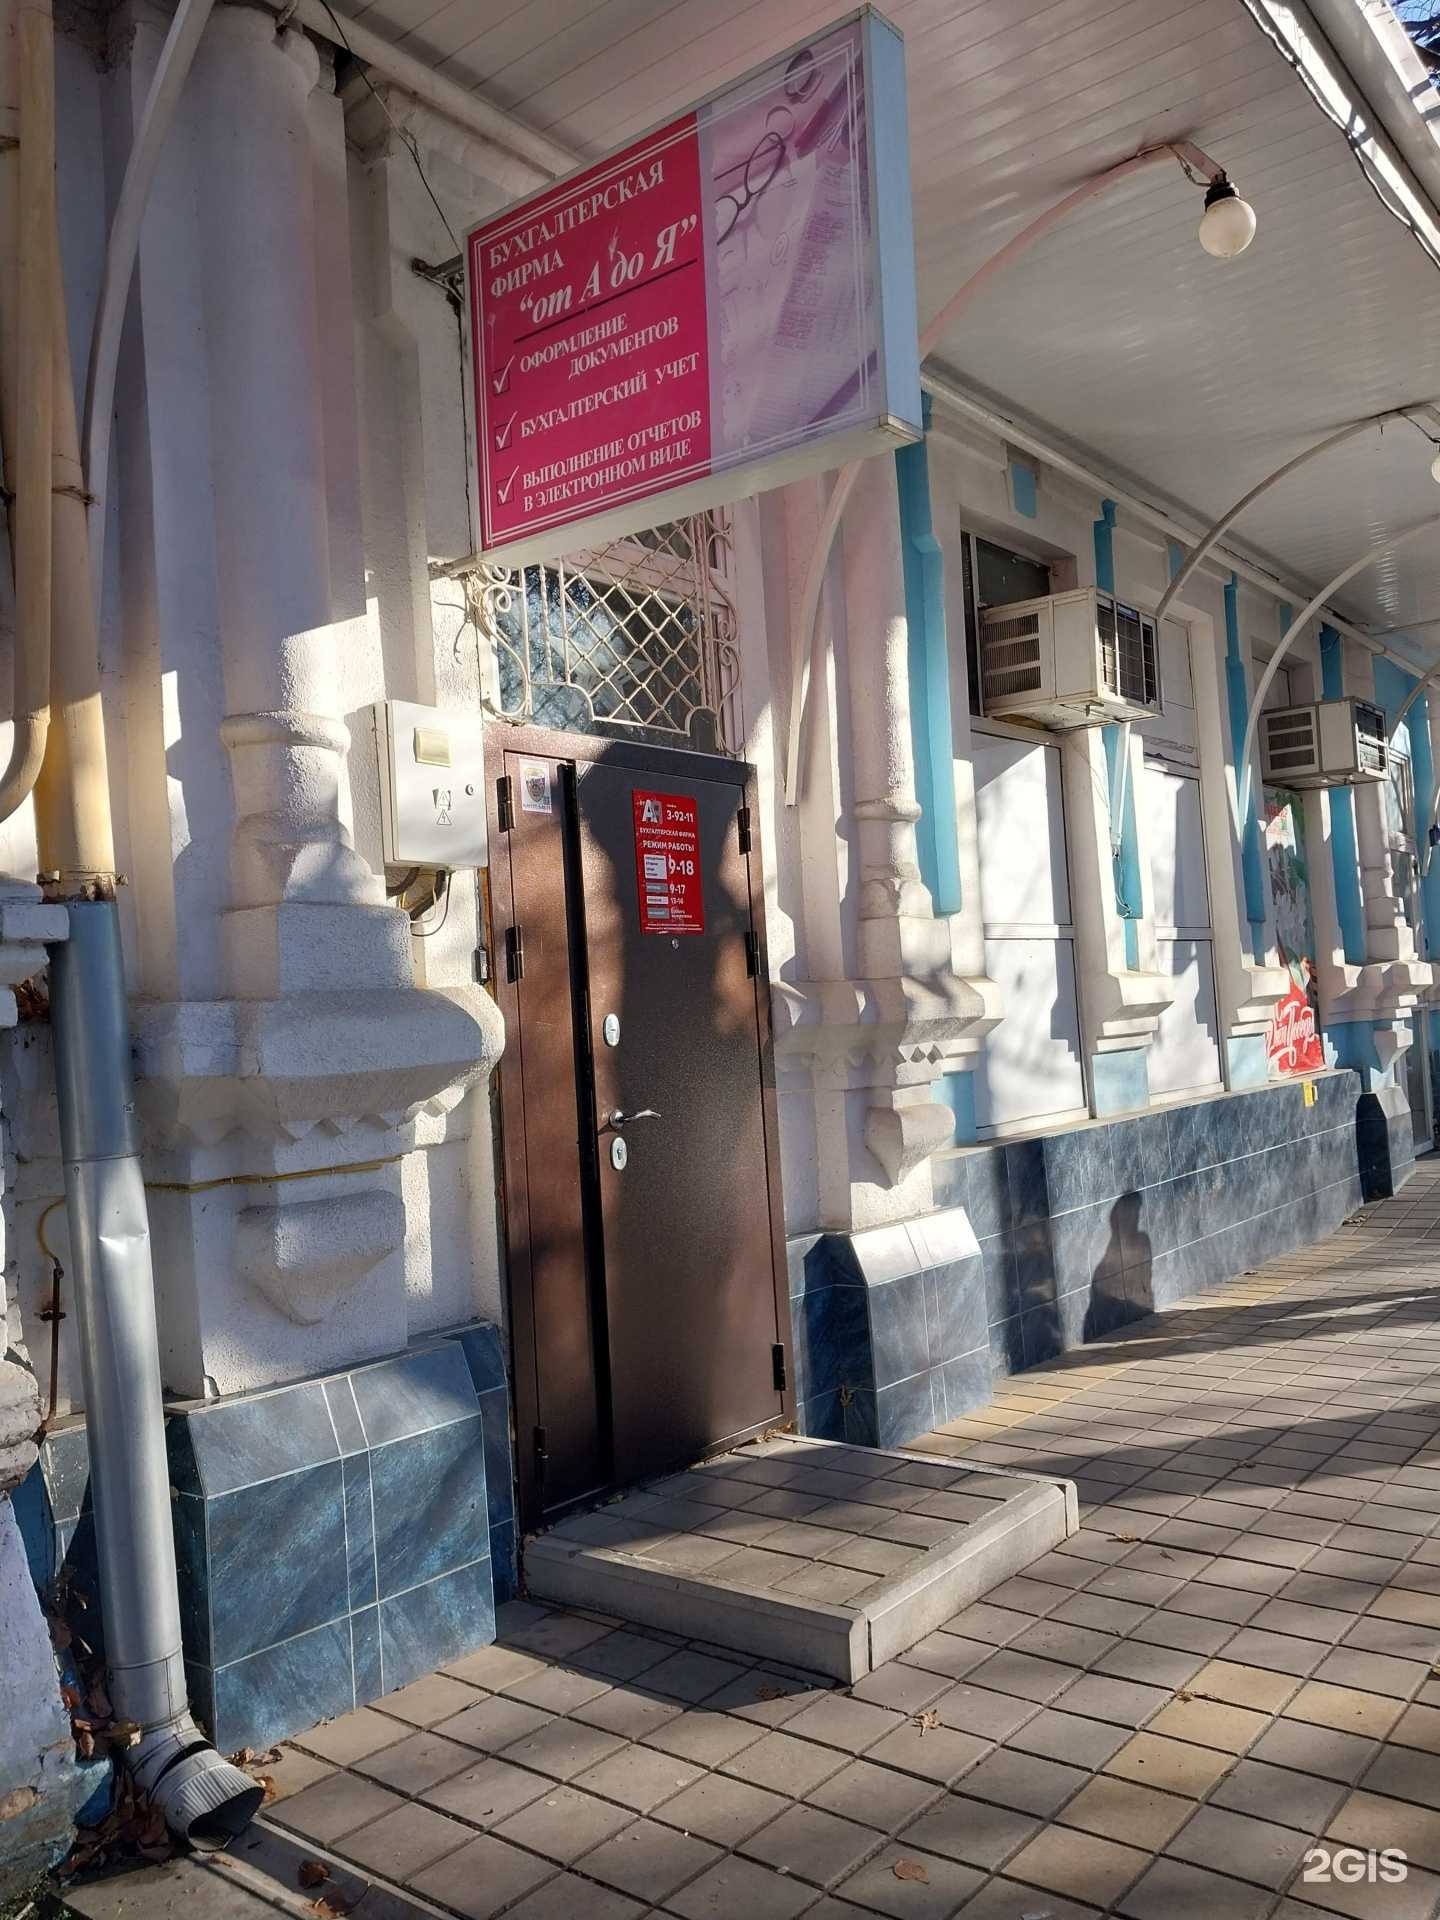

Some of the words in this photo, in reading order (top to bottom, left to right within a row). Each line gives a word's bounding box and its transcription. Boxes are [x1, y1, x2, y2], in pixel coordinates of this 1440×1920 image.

[489, 159, 665, 269] БУХГАЛТЕРСКАЯ
[490, 249, 565, 298] ФИРМА
[579, 261, 601, 304] А
[610, 250, 645, 289] до
[520, 313, 628, 373] ОФОРМЛЕНИЕ
[568, 316, 679, 380] ДОКУМЕНТОВ
[520, 369, 648, 439] БУХГАЛТЕРСКИЙ
[655, 352, 700, 385] УЧЕТ
[522, 438, 625, 490] ВЫПОЛНЕНИЕ
[627, 410, 702, 452] ОТЧЕТОВ
[523, 496, 534, 513] В
[535, 455, 646, 508] ЭЛЕКТРОННОМ
[650, 438, 692, 467] ВИДЕ
[642, 839, 668, 850] РЕЖИМ
[668, 842, 695, 852] РАБОТЫ
[666, 809, 694, 823] 3-92-11
[668, 857, 695, 876] 9-18
